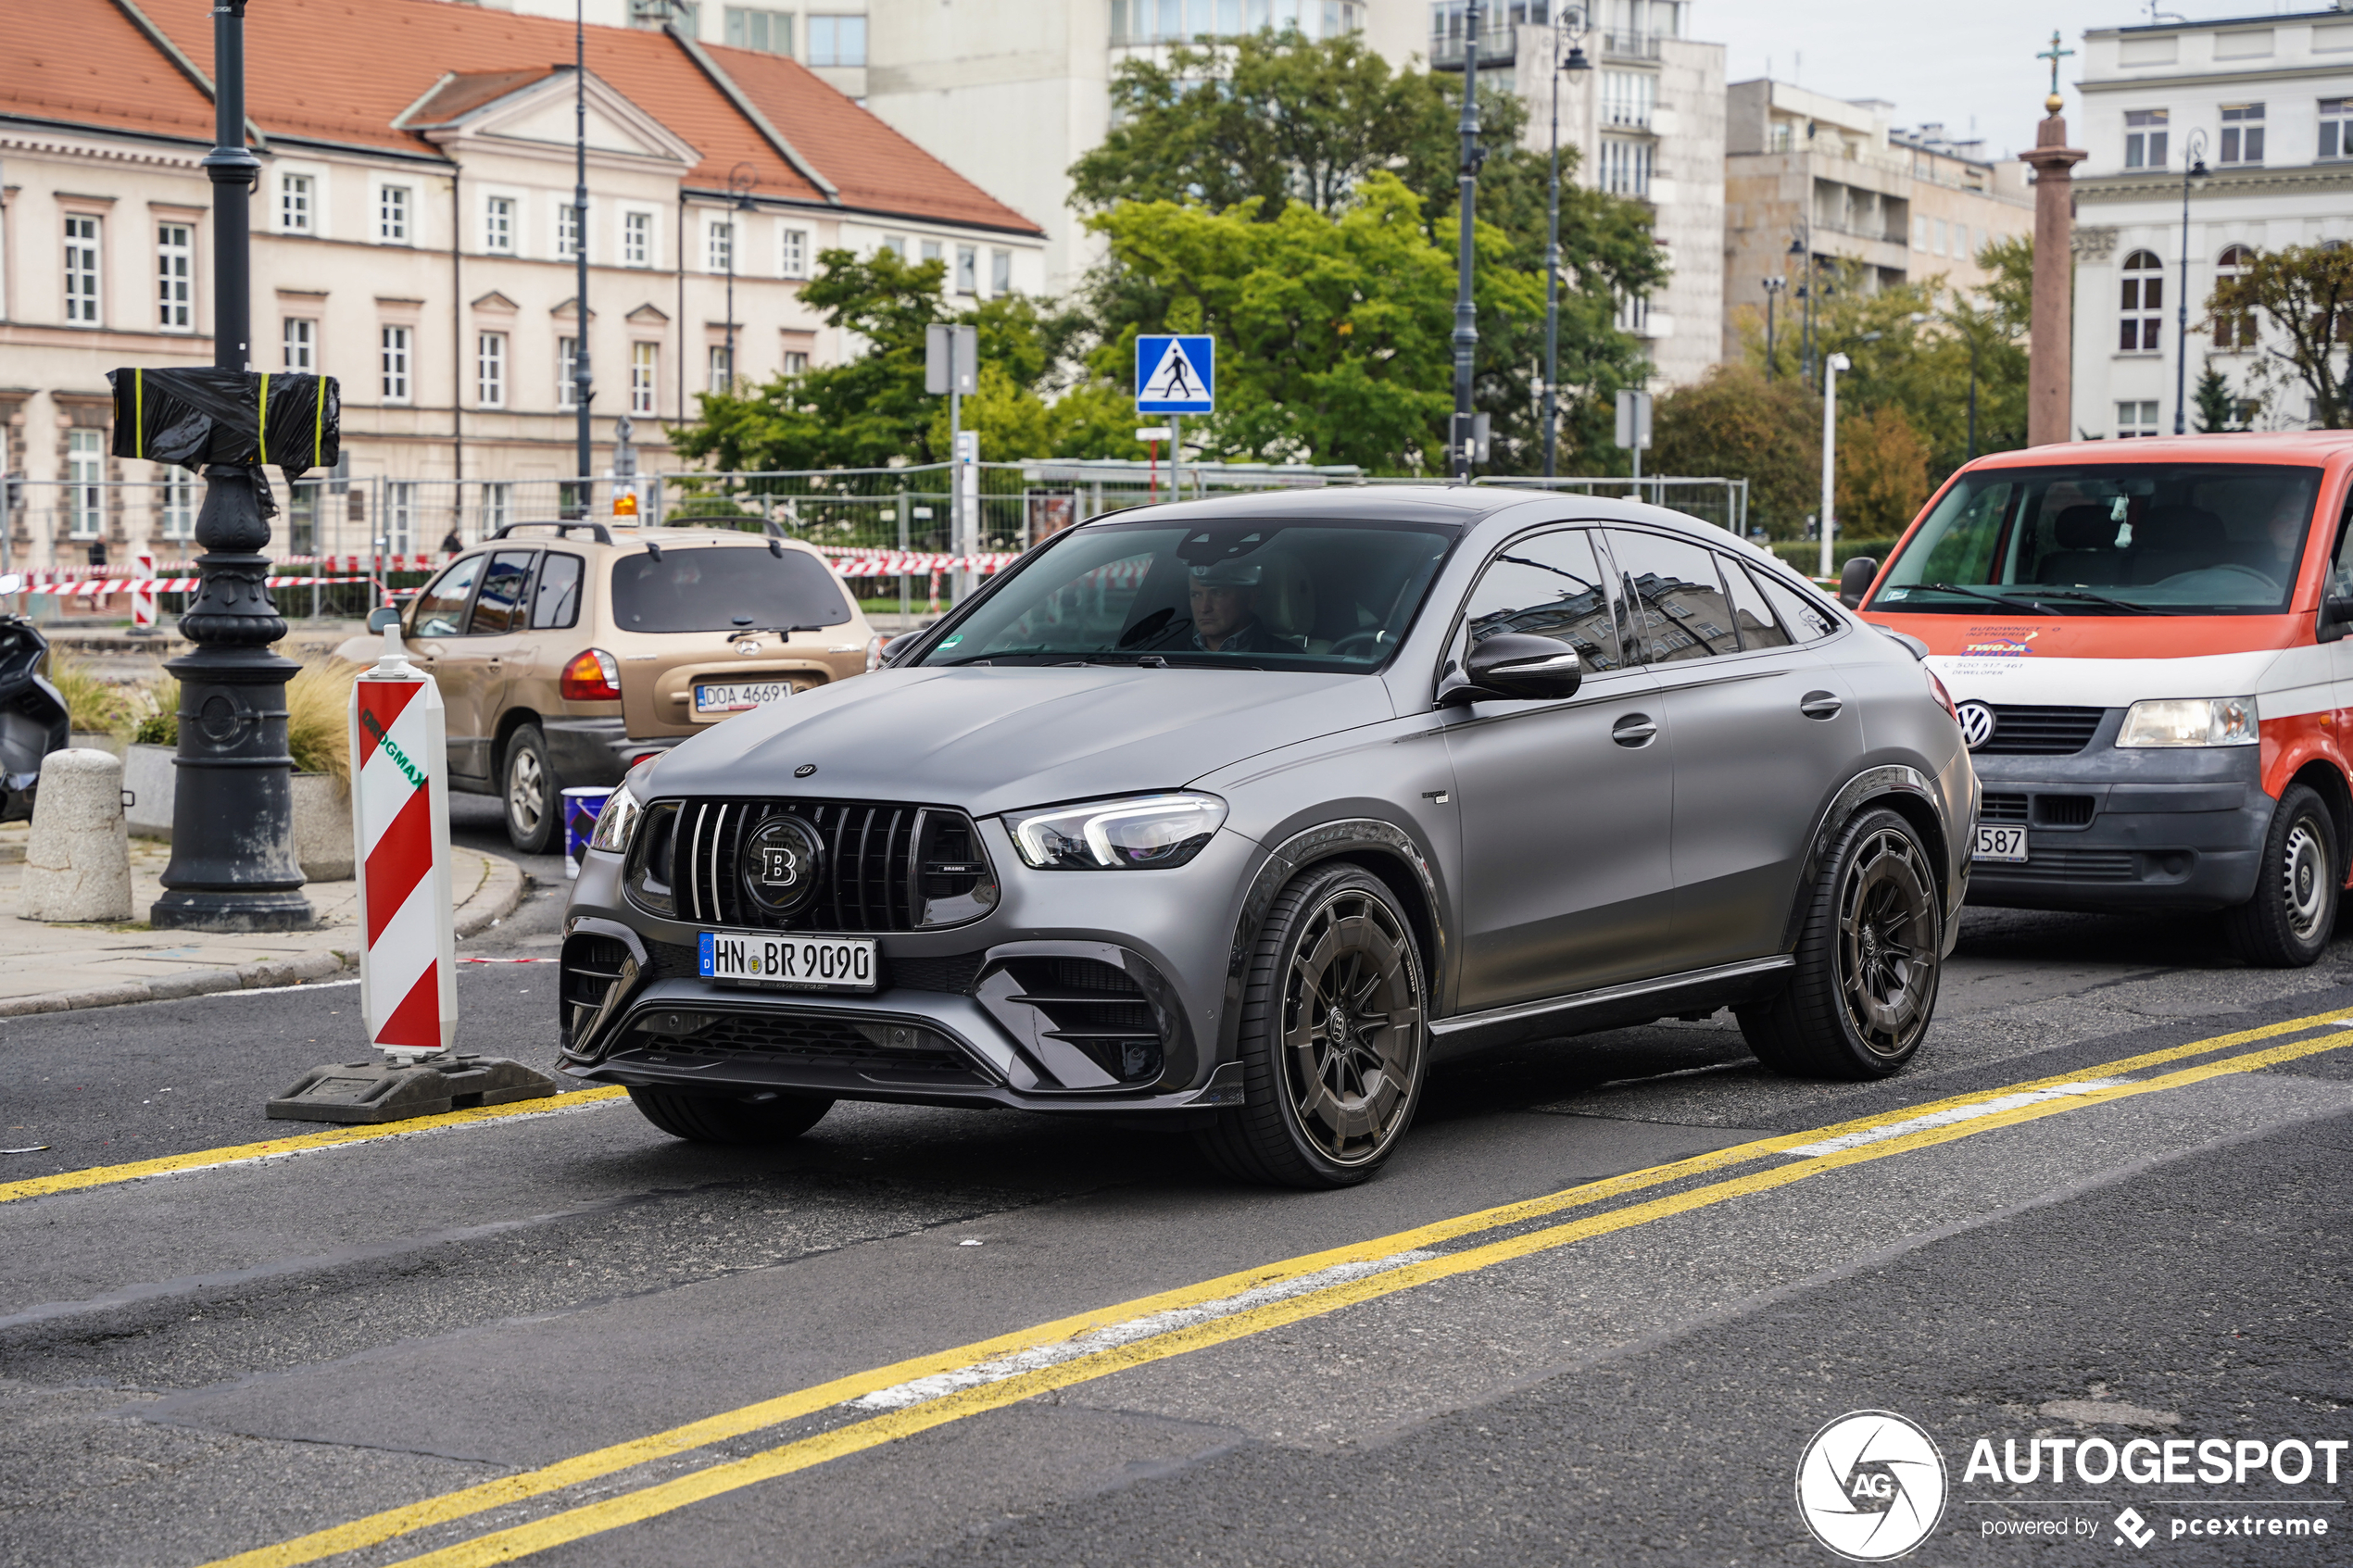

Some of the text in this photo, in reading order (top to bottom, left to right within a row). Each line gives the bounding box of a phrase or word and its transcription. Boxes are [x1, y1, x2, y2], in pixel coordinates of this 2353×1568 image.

[706, 687, 737, 705] DOA
[742, 684, 787, 703] 46691
[361, 708, 429, 792] DROGMAX
[1973, 830, 2021, 853] 587
[761, 847, 797, 885] B
[704, 959, 710, 969] D
[715, 940, 869, 980] HN BR 9090
